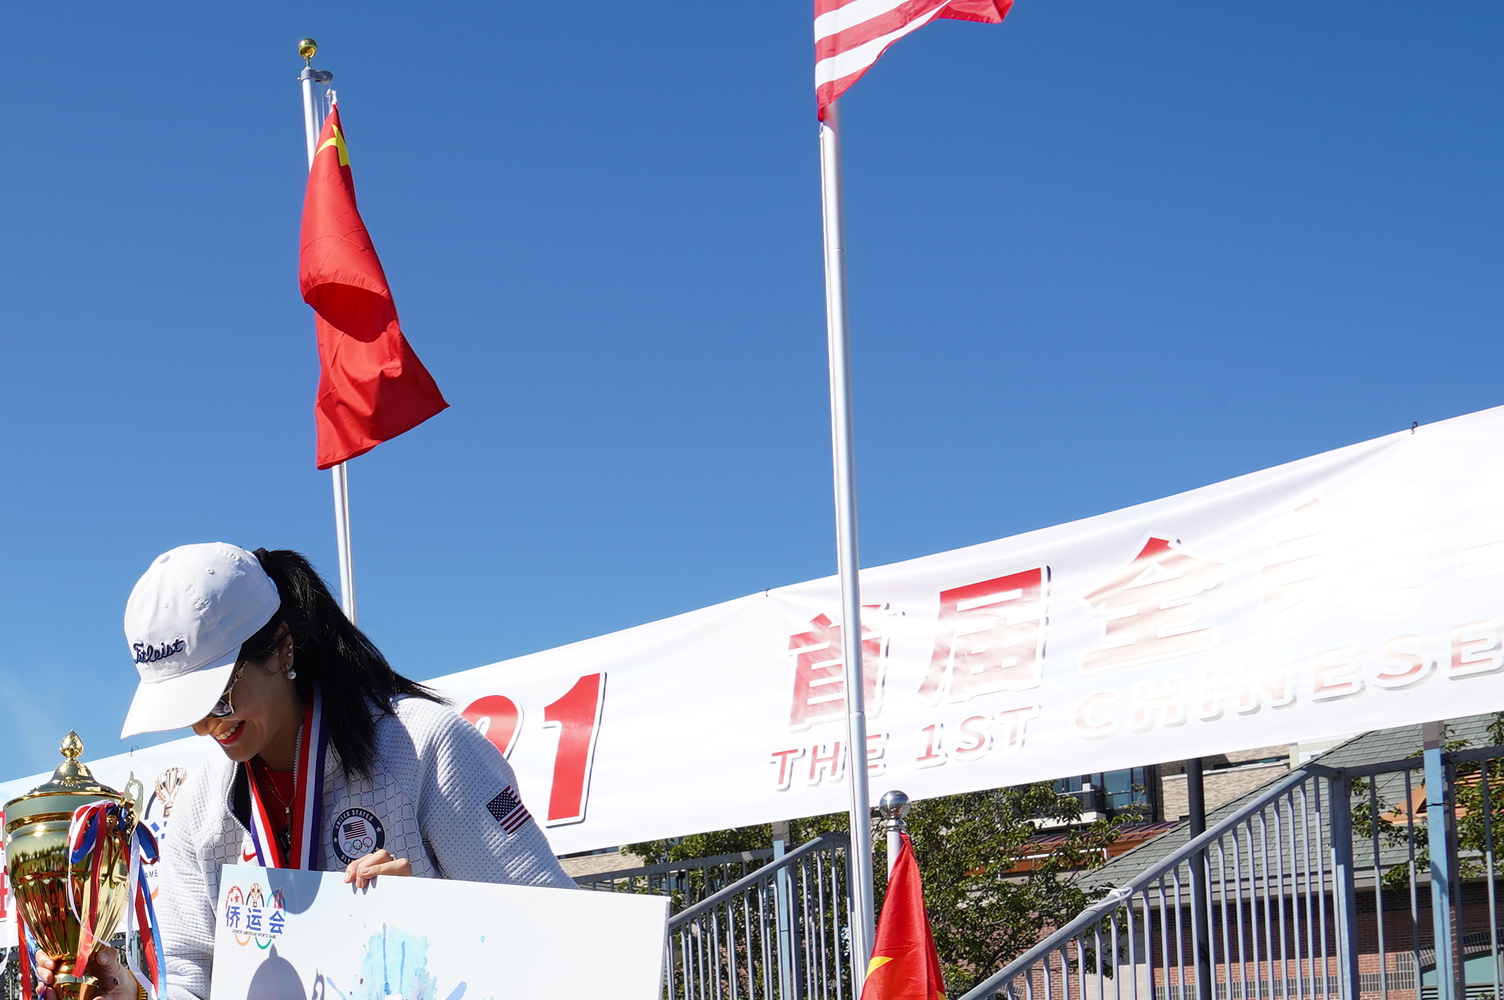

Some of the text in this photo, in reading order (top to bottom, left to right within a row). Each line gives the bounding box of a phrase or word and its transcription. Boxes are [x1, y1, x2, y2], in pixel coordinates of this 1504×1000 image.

[917, 706, 1036, 762] 1ST
[352, 809, 374, 822] STATES
[226, 905, 285, 934] 侨运会
